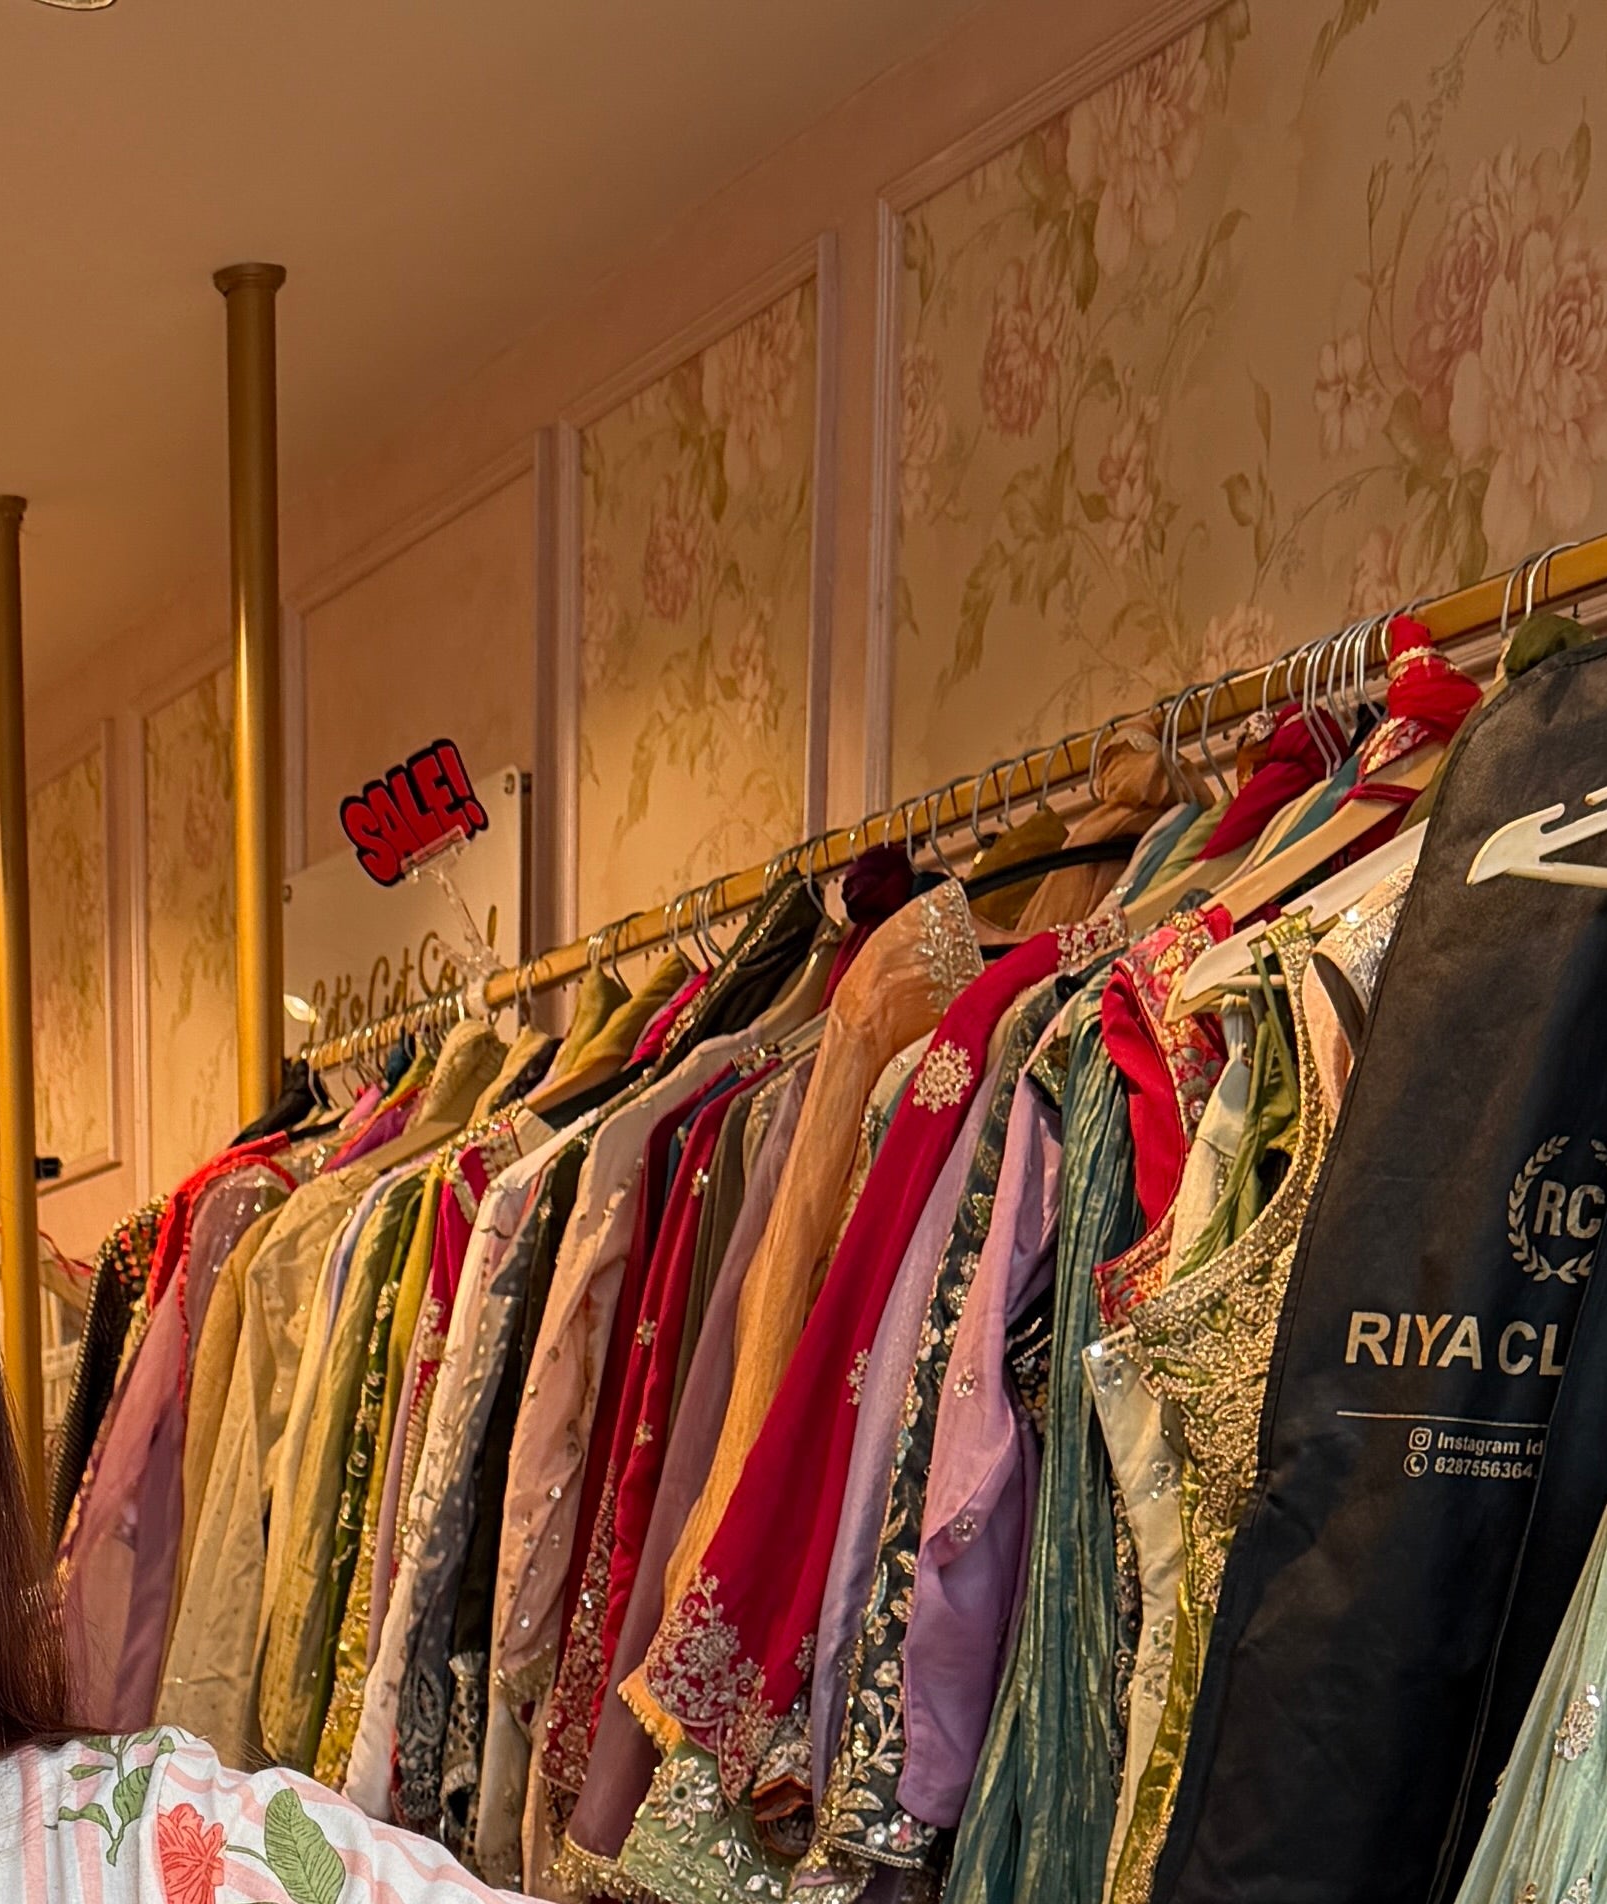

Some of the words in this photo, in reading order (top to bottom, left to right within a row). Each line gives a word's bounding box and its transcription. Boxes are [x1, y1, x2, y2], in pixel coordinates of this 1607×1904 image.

[341, 740, 487, 886] SALE!
[1345, 1311, 1482, 1371] RIYA
[1437, 1431, 1520, 1457] Instagram
